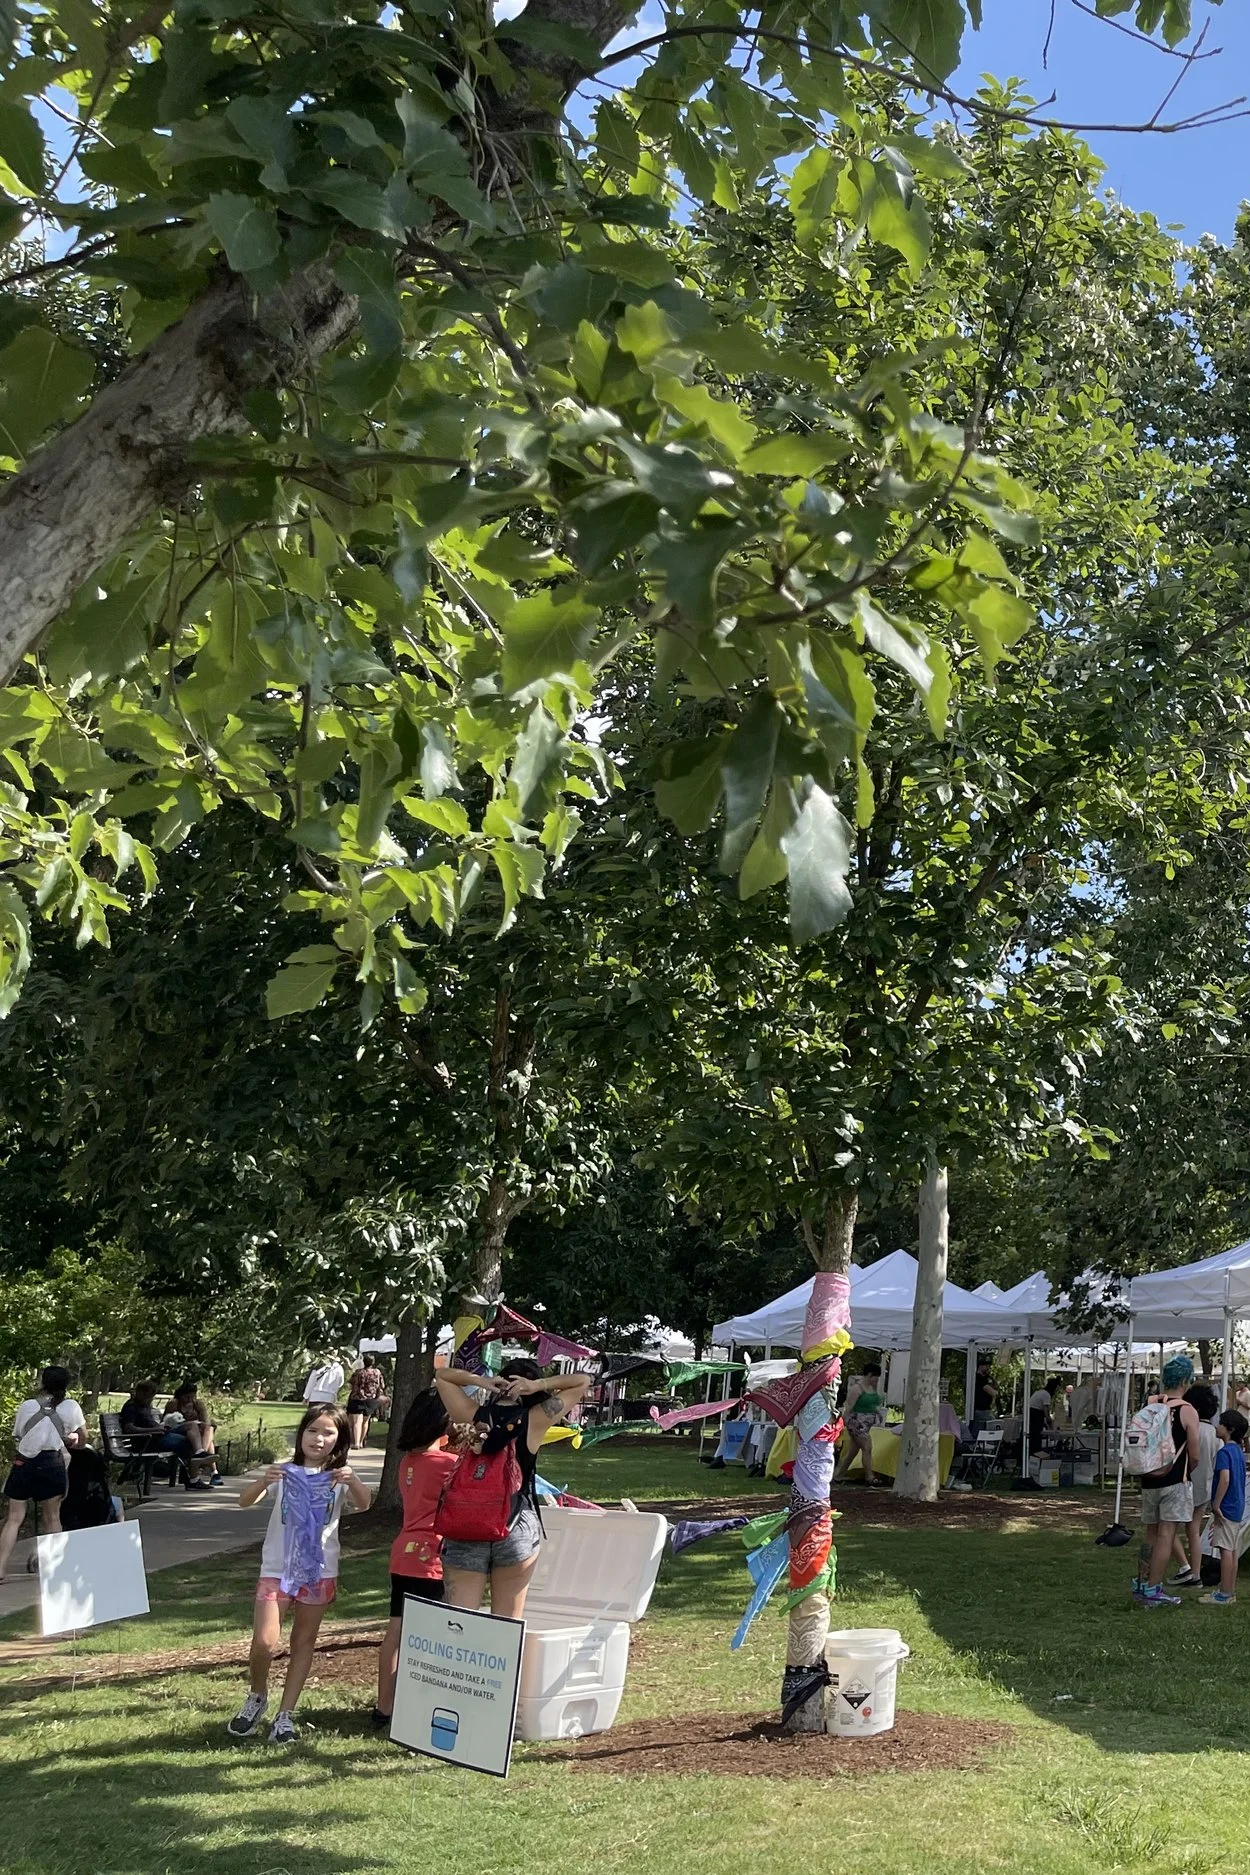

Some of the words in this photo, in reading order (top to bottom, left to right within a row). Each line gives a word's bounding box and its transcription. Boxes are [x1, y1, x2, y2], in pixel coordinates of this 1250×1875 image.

[408, 1635, 453, 1659] COOLING
[456, 1648, 506, 1671] STATION
[407, 1658, 419, 1667] STAY
[420, 1661, 450, 1677] REFRESHED
[451, 1671, 464, 1681] AND
[465, 1673, 480, 1685] TAKE
[487, 1679, 502, 1689] FREE
[410, 1671, 421, 1681] ICED
[421, 1675, 447, 1688] BANDANA
[448, 1682, 472, 1696] AND/OR
[473, 1689, 496, 1701] WATER.
